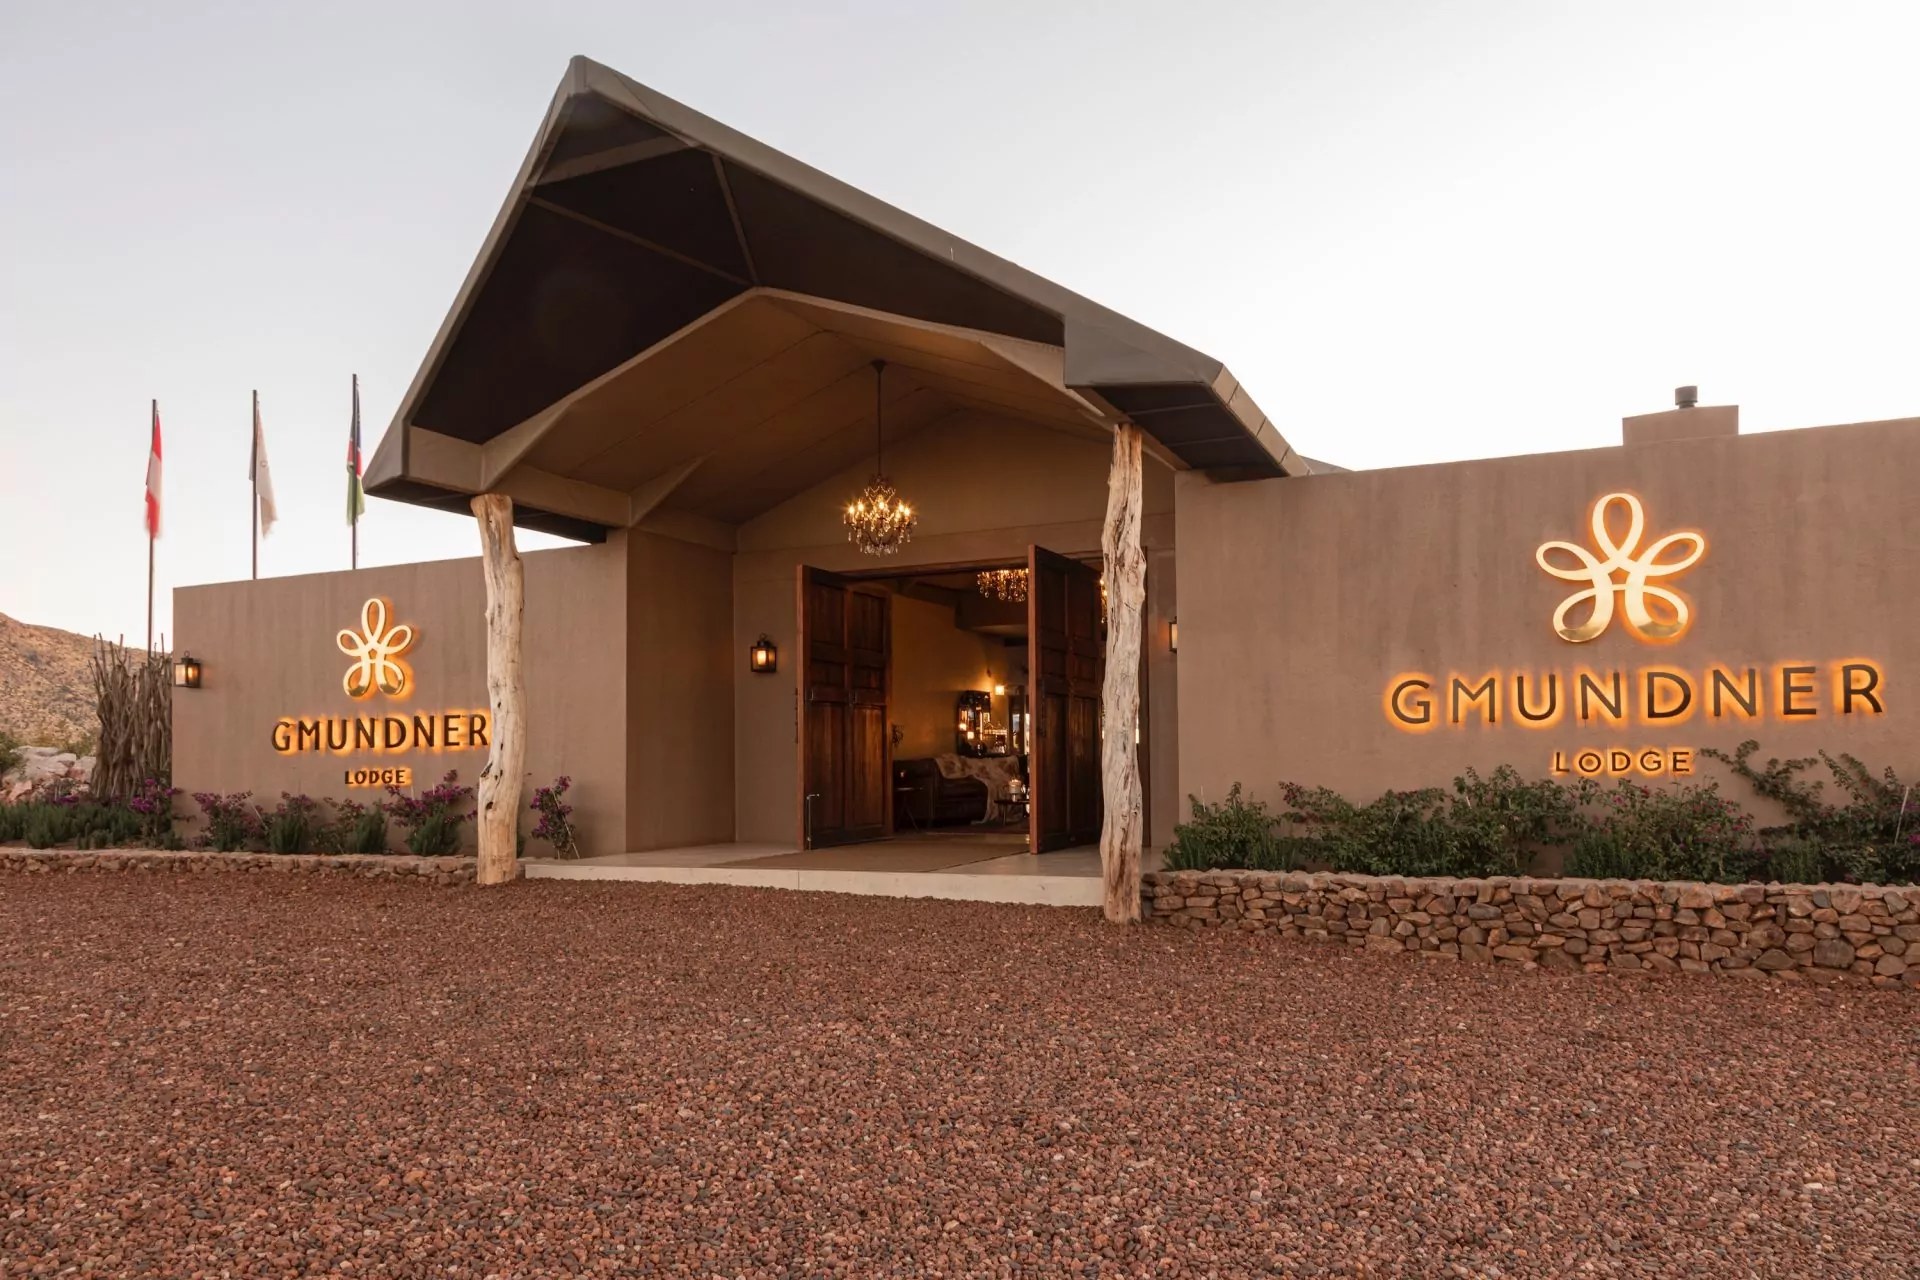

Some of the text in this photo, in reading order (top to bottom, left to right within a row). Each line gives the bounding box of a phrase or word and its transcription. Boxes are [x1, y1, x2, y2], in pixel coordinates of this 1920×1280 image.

[1391, 663, 1884, 725] GMUNDNER
[271, 713, 489, 751] GMUNDNER
[1554, 750, 1691, 773] LODGE
[344, 769, 406, 785] LODGE
